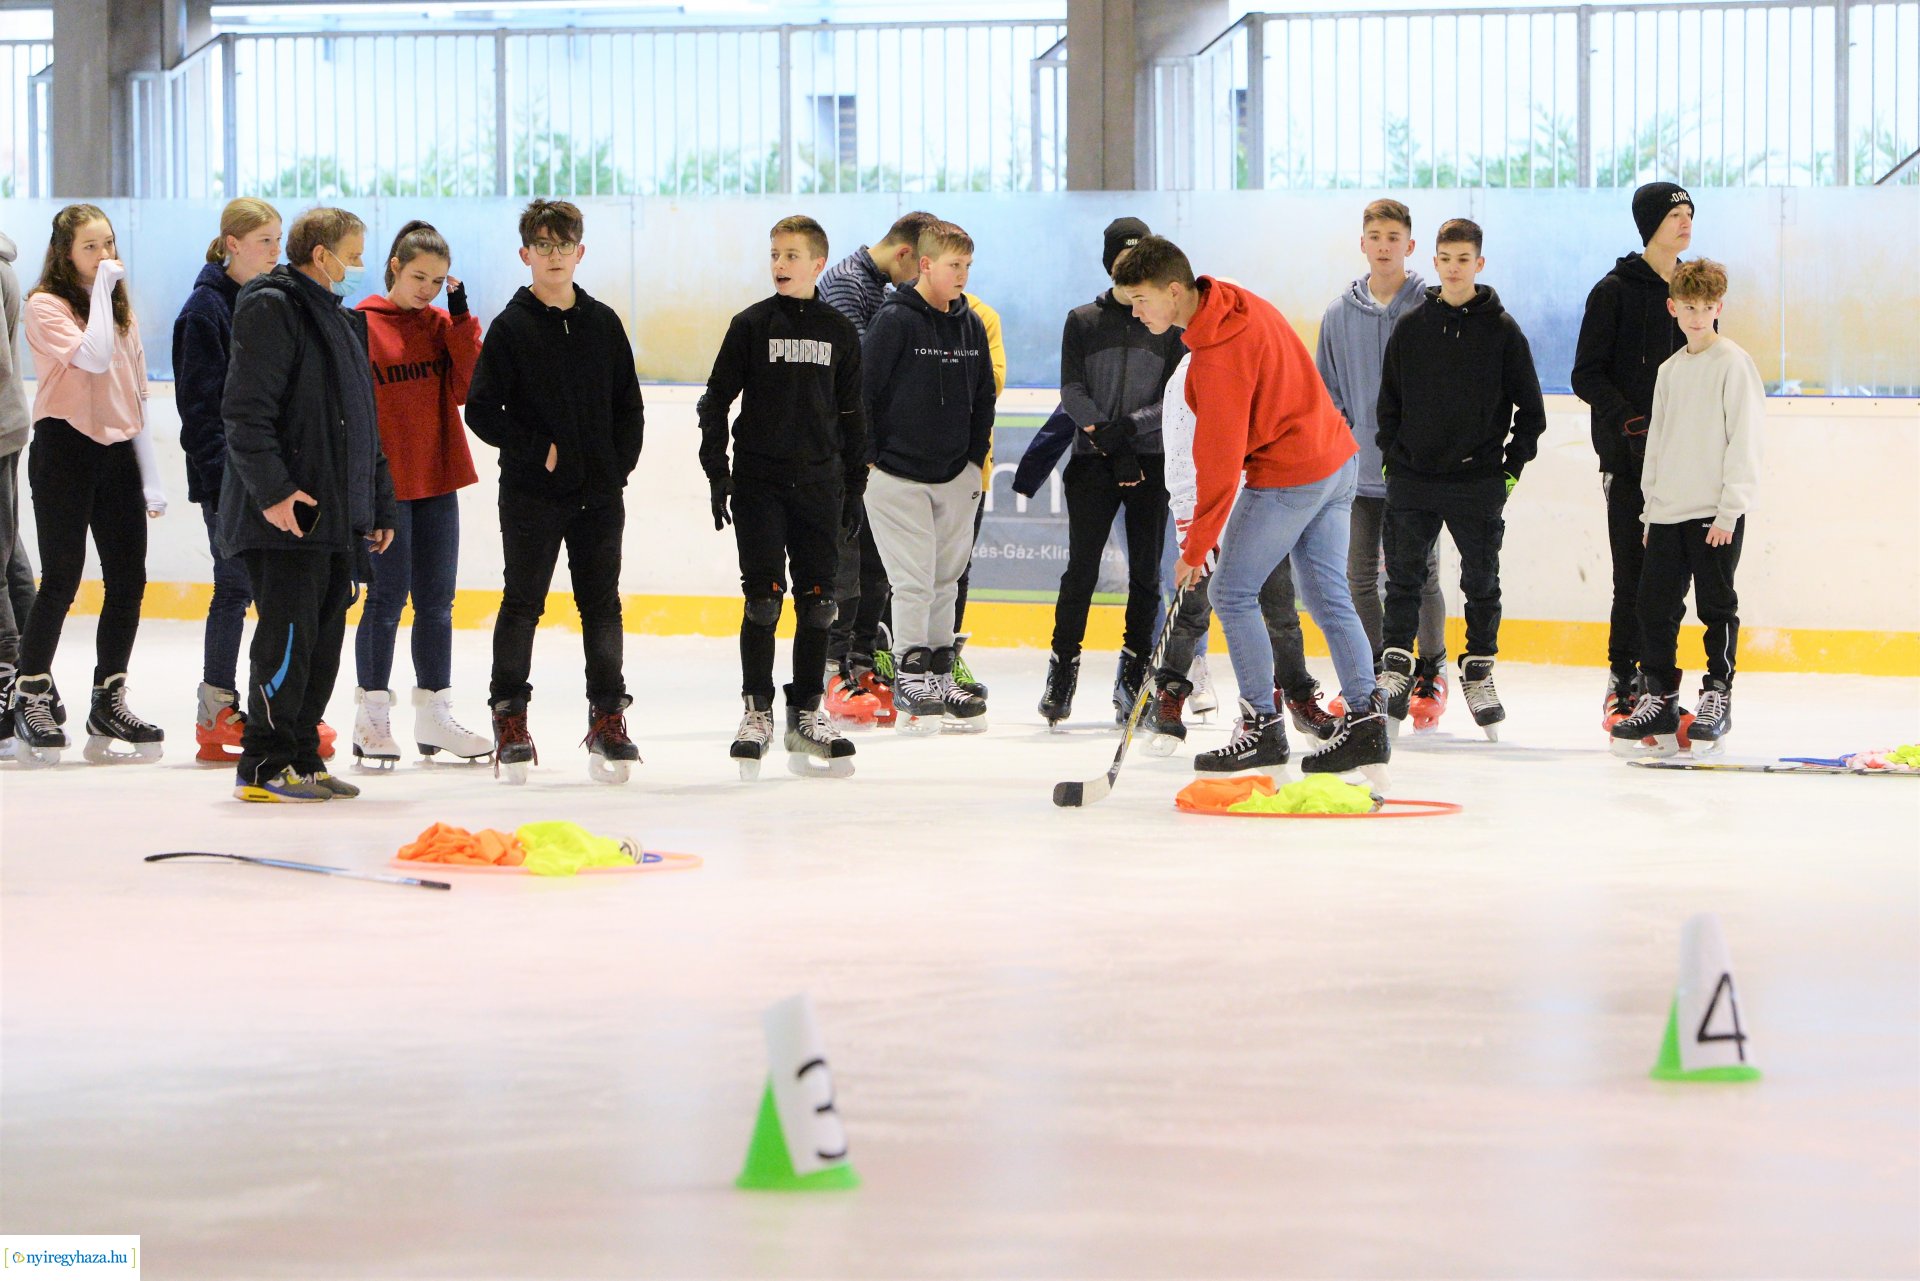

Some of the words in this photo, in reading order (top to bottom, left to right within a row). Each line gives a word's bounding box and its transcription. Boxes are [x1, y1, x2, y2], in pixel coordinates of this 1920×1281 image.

[768, 338, 832, 366] PUMA
[914, 348, 943, 356] TOMMY
[953, 349, 980, 357] HILIGR
[1387, 654, 1408, 663] CCM
[1697, 971, 1747, 1062] 4
[796, 1057, 848, 1160] 3
